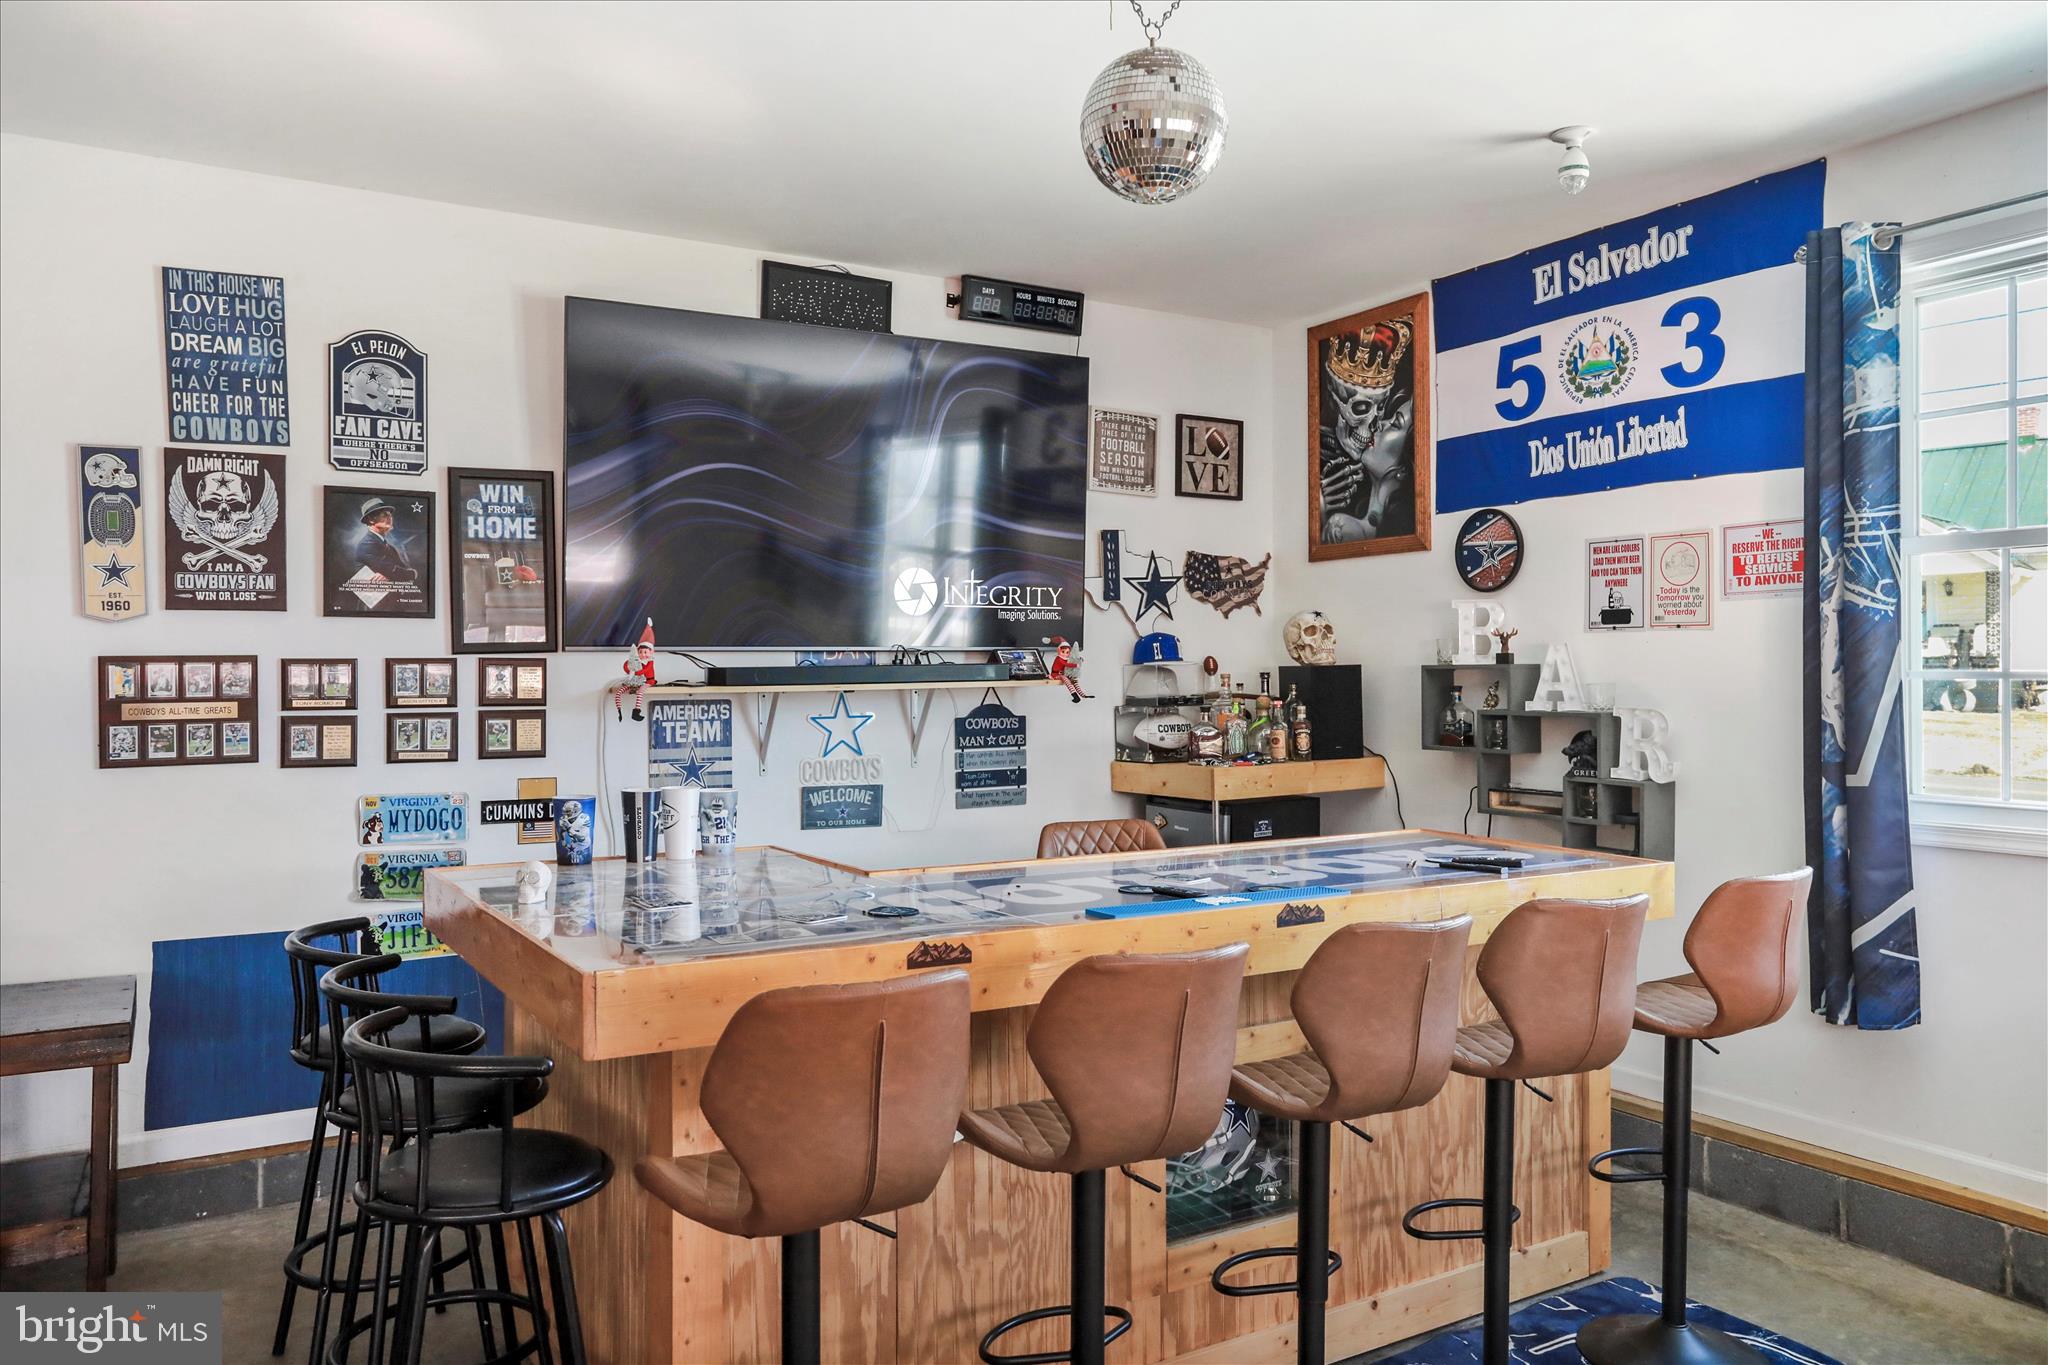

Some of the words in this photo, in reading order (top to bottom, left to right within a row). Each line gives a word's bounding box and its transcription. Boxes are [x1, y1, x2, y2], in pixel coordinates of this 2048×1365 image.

[1532, 259, 1563, 305] El
[1568, 225, 1693, 294] Salvador
[169, 269, 181, 290] IN
[187, 271, 214, 293] THIS
[219, 273, 257, 296] HOUSE
[262, 278, 281, 299] WE
[169, 292, 230, 316] LOVE
[236, 299, 282, 319] HUG
[1016, 292, 1031, 300] HOURS
[1058, 299, 1077, 307] SECONDS
[171, 315, 228, 332] LAUGH
[235, 319, 246, 334] A
[252, 321, 283, 336] LOT
[1614, 319, 1622, 327] LA
[1565, 317, 1597, 346] SALVADOR
[171, 332, 242, 354] DREAM
[249, 338, 284, 358] BIG
[351, 341, 366, 355] EL
[370, 340, 407, 360] PELON
[1624, 328, 1638, 361] AMERICA
[172, 356, 201, 369] are
[209, 354, 284, 376] grateful
[1495, 335, 1546, 421] 5
[1660, 296, 1726, 388] 3
[172, 374, 229, 392] HAVE
[242, 379, 283, 394] FUN
[1559, 374, 1583, 404] REPUBLICA
[1613, 367, 1636, 398] CENTRAL
[172, 392, 219, 414] CHEER
[227, 395, 252, 415] FOR
[259, 397, 285, 417] THE
[173, 415, 288, 444] COWBOYS
[335, 416, 370, 437] FAN
[377, 419, 422, 440] CAVE
[342, 439, 375, 448] WHERE
[378, 441, 415, 450] THERE'S
[1101, 437, 1145, 454] FOOTBALL
[1528, 436, 1564, 477] Dios
[1566, 426, 1616, 470] Unión
[1616, 405, 1688, 460] Libertad
[369, 450, 388, 460] NO
[1100, 451, 1144, 468] SEASON
[188, 456, 222, 474] DAMN
[224, 458, 259, 476] RIGHT
[351, 460, 407, 470] OFFSEASON
[1100, 473, 1123, 481] FOOTBALL
[479, 484, 524, 503] WIN
[488, 506, 516, 514] FROM
[467, 516, 536, 539] HOME
[1762, 529, 1774, 539] WE
[1612, 545, 1620, 553] LIKE
[1621, 544, 1639, 552] COOLERS
[1733, 541, 1764, 553] RESERVE
[1766, 540, 1780, 550] THE
[1605, 557, 1616, 565] THEM
[1617, 556, 1628, 564] WITH
[1629, 555, 1639, 563] BEER
[1739, 555, 1753, 565] TO
[1757, 552, 1799, 564] REFUSE
[207, 563, 212, 571] I
[215, 563, 232, 572] AM
[235, 564, 243, 572] A
[1610, 568, 1618, 576] CAN
[1620, 567, 1629, 575] TAKE
[1745, 563, 1793, 575] SERVICE
[176, 574, 246, 589] COWBOYS
[249, 575, 274, 590] FAN
[1605, 579, 1627, 587] ANYWHERE
[1736, 577, 1751, 586] TO
[1755, 573, 1802, 585] ANYONE
[196, 592, 216, 600] WIN
[219, 592, 231, 600] OR
[233, 592, 256, 600] LOSE
[101, 601, 130, 611] 1960
[998, 610, 1025, 621] Imaging
[128, 708, 166, 716] COWBOYS
[169, 707, 200, 715] ALL-TIME
[653, 704, 729, 720] AMERICA'S
[965, 718, 1018, 729] COWBOYS
[662, 721, 720, 743] TEAM
[960, 736, 984, 746] MAN
[999, 735, 1024, 745] CAVE
[802, 758, 880, 783] COWBOYS
[390, 798, 438, 806] VIRGINIA
[809, 788, 873, 806] WELCOME
[389, 808, 462, 832] MYDOGO
[486, 803, 544, 821] CUMMINS
[714, 817, 725, 829] 21
[714, 835, 729, 843] THE
[388, 854, 438, 863] VIRGINIA
[387, 912, 423, 922] VIRGIN
